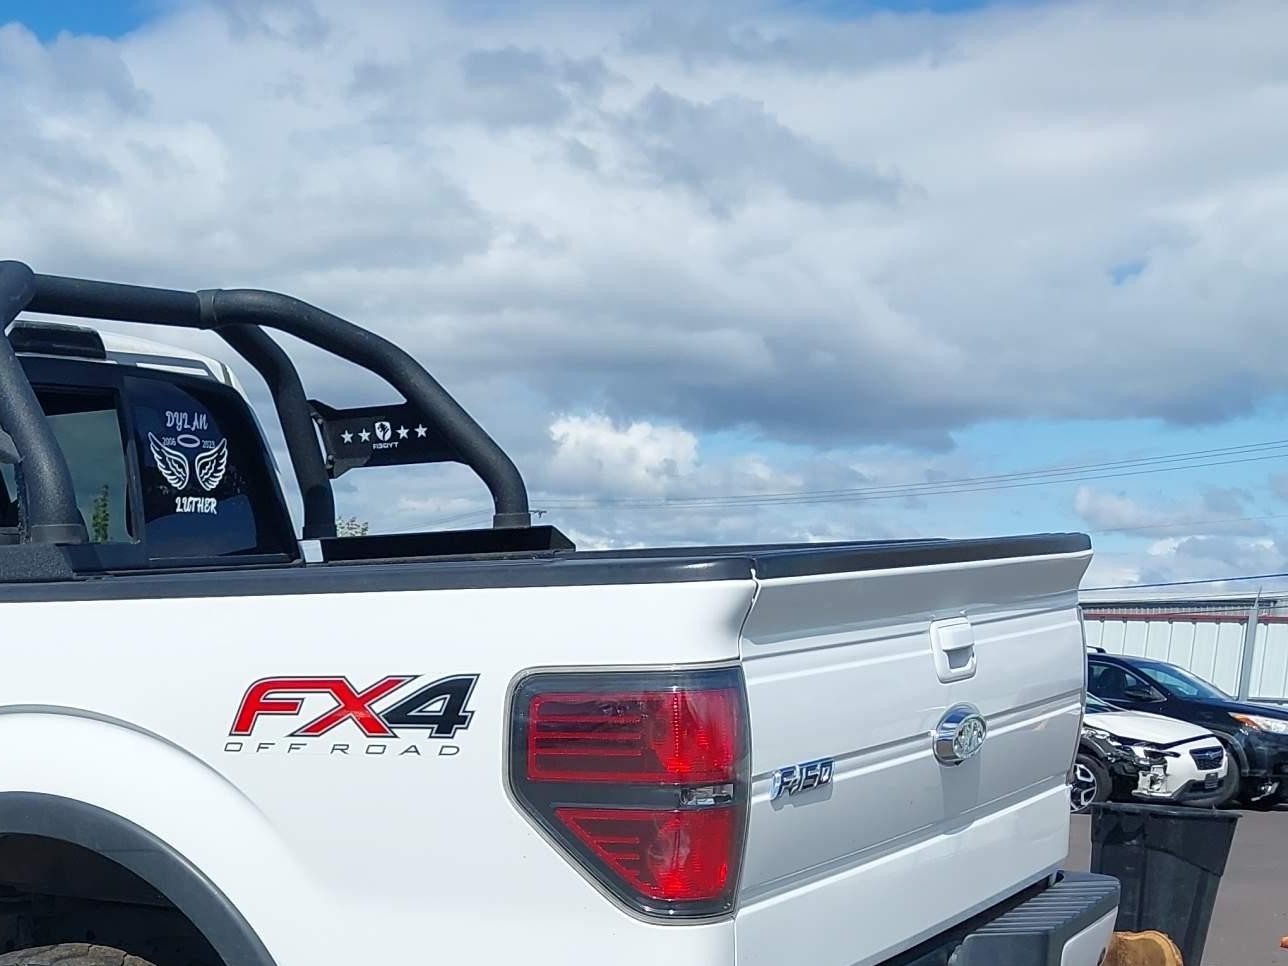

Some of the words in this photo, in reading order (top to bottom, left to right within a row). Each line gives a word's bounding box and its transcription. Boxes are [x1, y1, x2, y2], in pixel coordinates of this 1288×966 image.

[165, 410, 209, 432] DYLAN
[175, 496, 218, 515] LUTHER
[228, 673, 481, 739] FX4
[224, 742, 307, 754] OFF
[329, 743, 461, 756] ROAD
